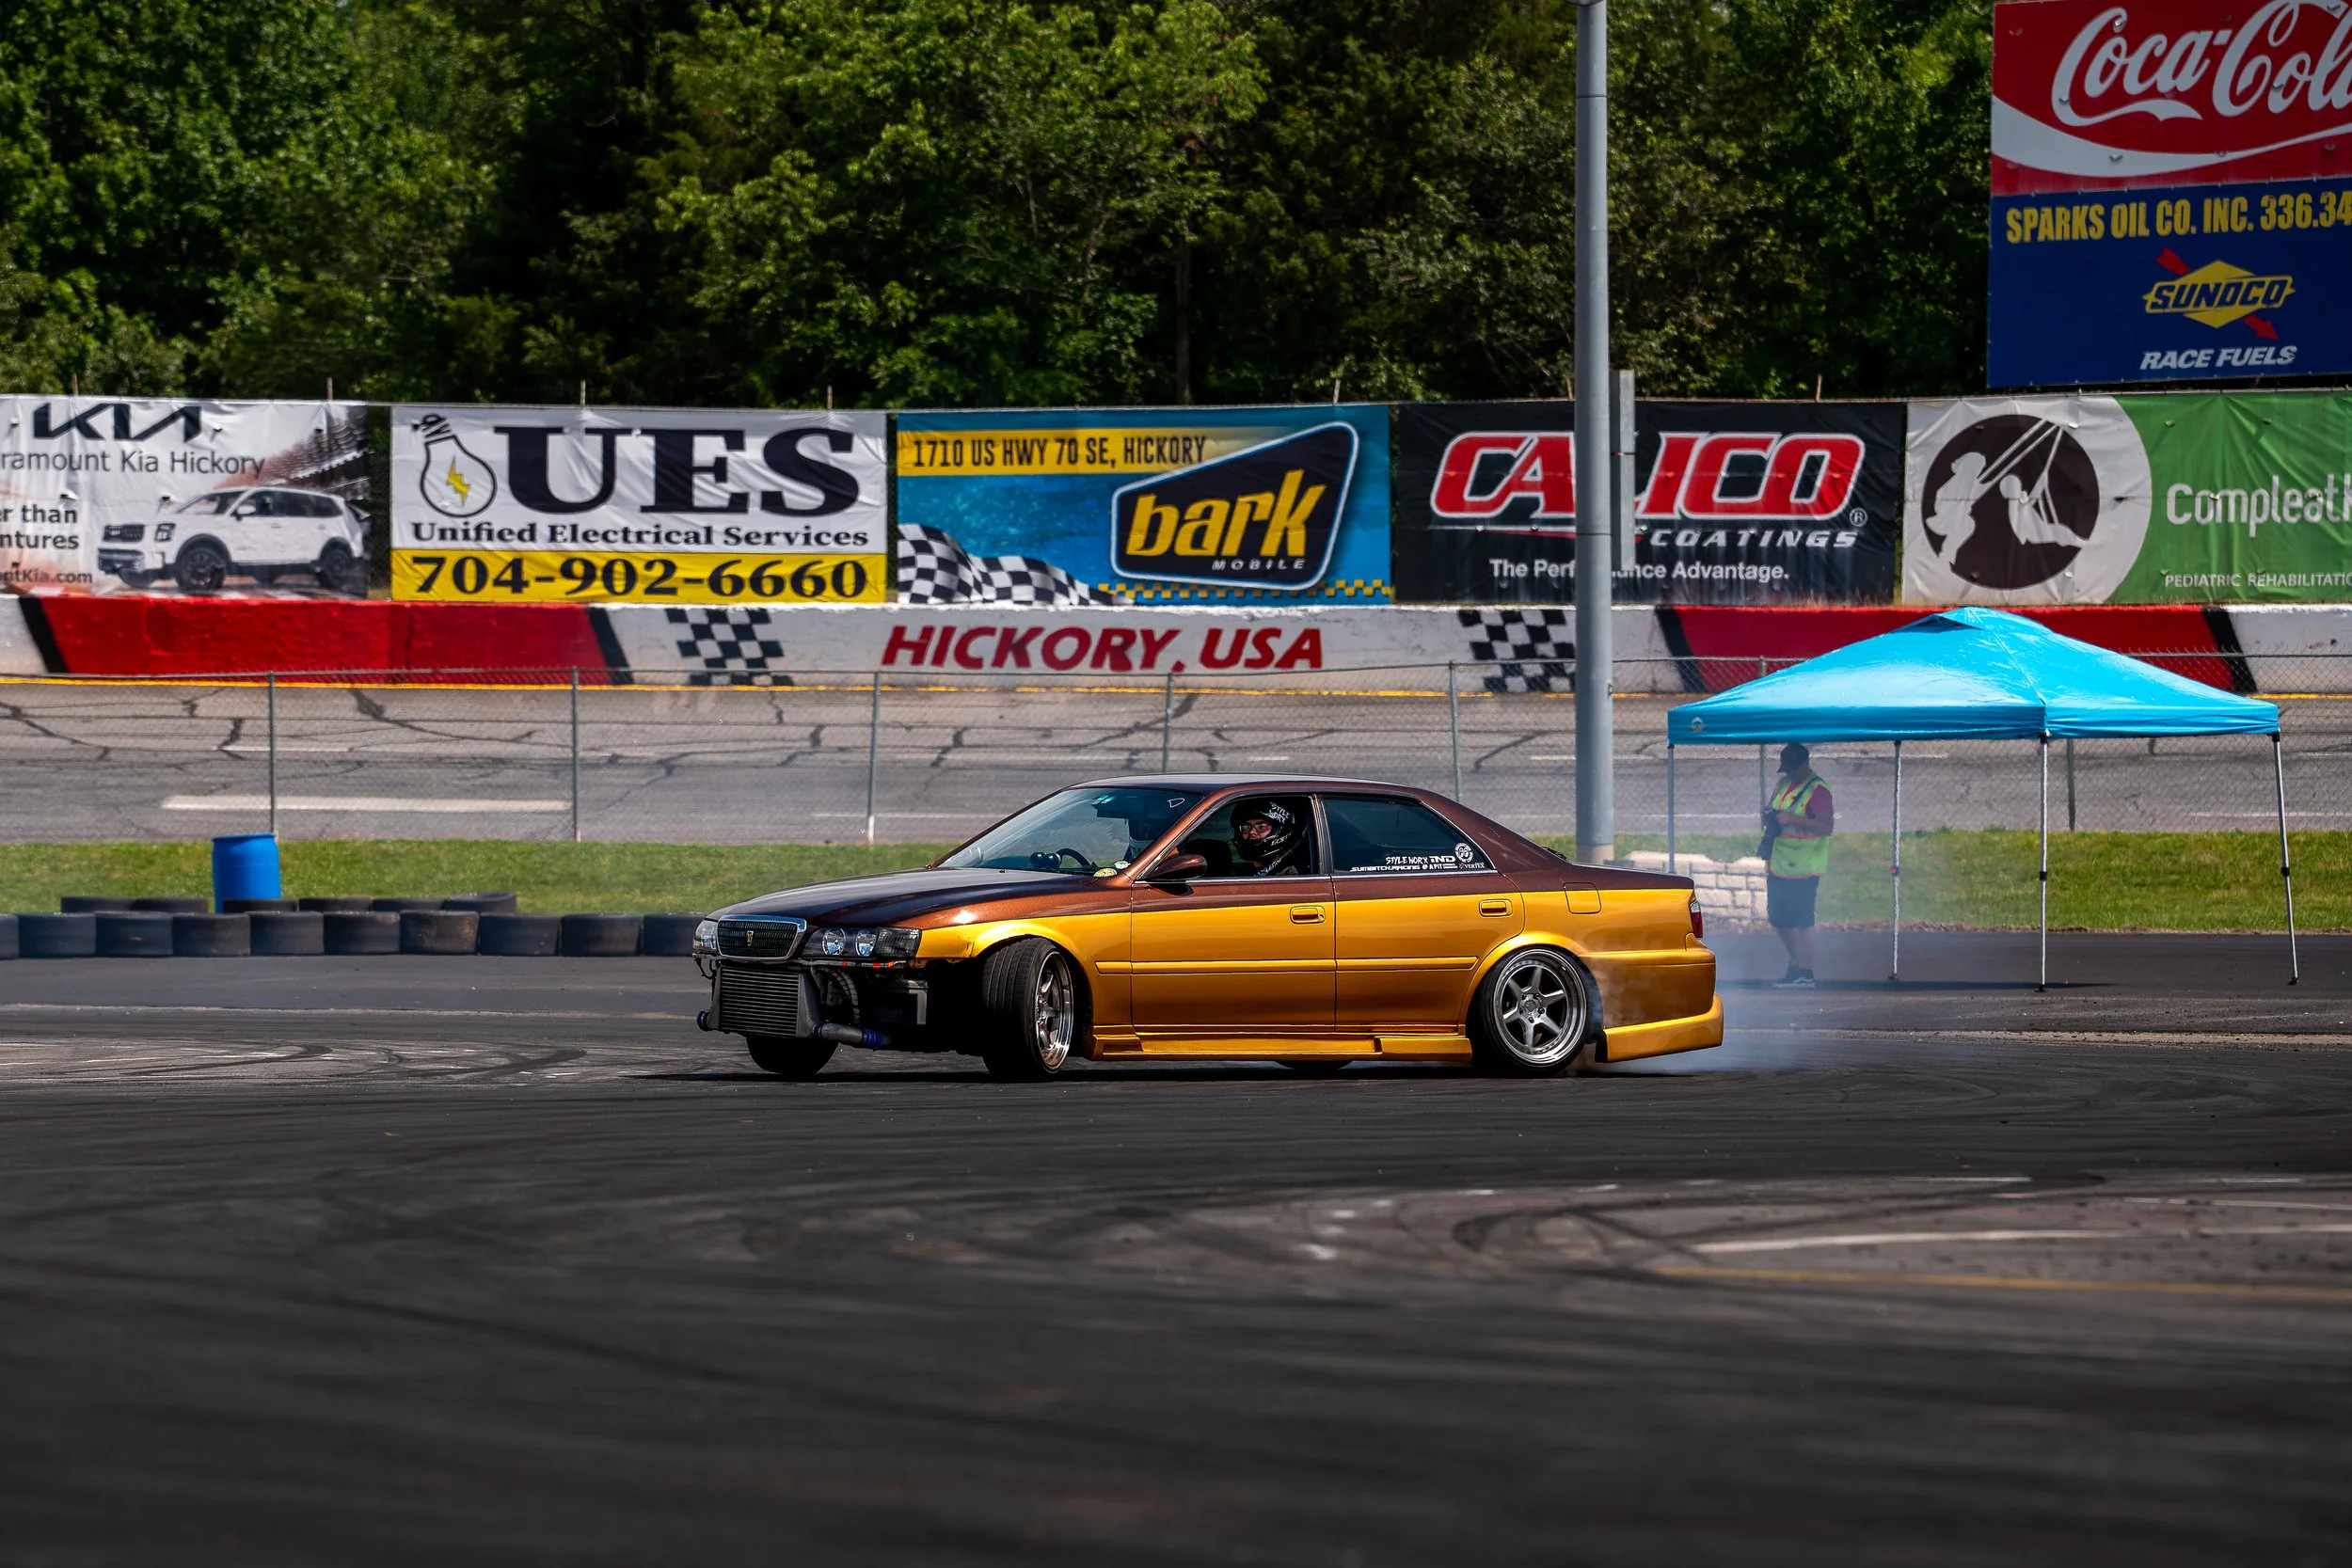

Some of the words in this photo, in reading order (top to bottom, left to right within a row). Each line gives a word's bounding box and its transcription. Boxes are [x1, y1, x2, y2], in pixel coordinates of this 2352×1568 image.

[2006, 203, 2106, 244] SPARKS
[2110, 202, 2150, 238] OIL
[2155, 199, 2197, 235] CO.
[2203, 197, 2254, 233] INC.
[2260, 190, 2352, 231] 336.34
[2149, 277, 2288, 309] SUNOCO
[2140, 349, 2214, 370] RACE
[2216, 345, 2297, 367] FUELS
[33, 403, 202, 443] KIA
[121, 451, 159, 472] Kia
[170, 451, 265, 481] Hickory
[914, 439, 964, 467] 1710
[971, 438, 994, 466] US
[1003, 437, 1049, 466] HWY
[1056, 437, 1078, 466] 70
[1086, 436, 1116, 468] SE,
[1123, 436, 1207, 464] HICKORY
[494, 425, 860, 517] UES
[1430, 430, 1867, 521] CAICO
[21, 504, 78, 524] than
[1126, 469, 1327, 557] bark
[411, 521, 536, 544] Unified
[548, 522, 713, 546] Electrical
[723, 525, 869, 547] Services
[1649, 529, 1859, 548] COATINGS
[411, 555, 867, 597] 704-902-6660
[1211, 559, 1307, 571] MOBILE
[1488, 559, 1528, 578] The
[1534, 559, 1667, 578] Perfnce
[1671, 561, 1789, 583] Advantage.
[2165, 573, 2242, 588] PEDIATRIC
[883, 625, 1186, 673] HICKORY,
[1199, 627, 1323, 670] USA
[1385, 856, 1407, 865] STYLE
[1407, 856, 1429, 865] WORX
